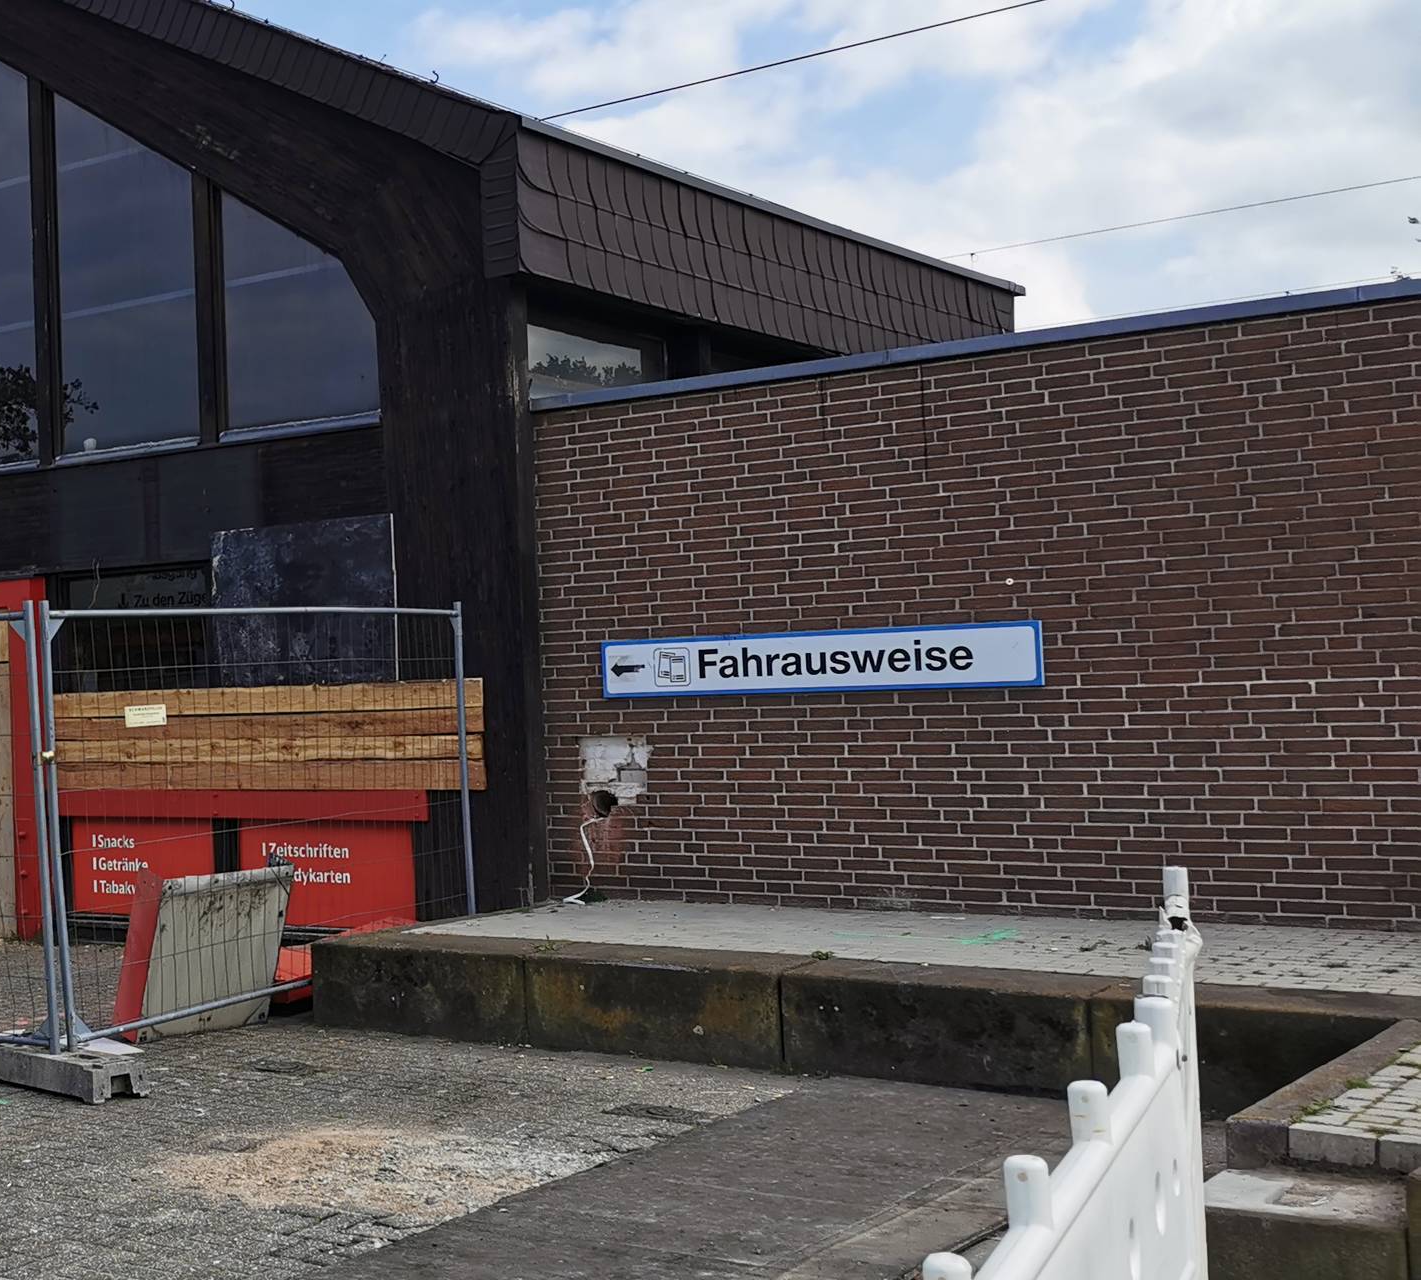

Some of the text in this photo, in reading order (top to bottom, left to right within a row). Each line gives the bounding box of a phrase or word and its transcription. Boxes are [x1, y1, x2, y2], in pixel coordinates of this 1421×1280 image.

[133, 594, 149, 608] Zu
[152, 594, 174, 606] den
[698, 639, 974, 679] Fahrausweise
[98, 835, 135, 848] Snacks
[269, 843, 349, 859] Zeitschriften
[98, 858, 149, 872] Getränke
